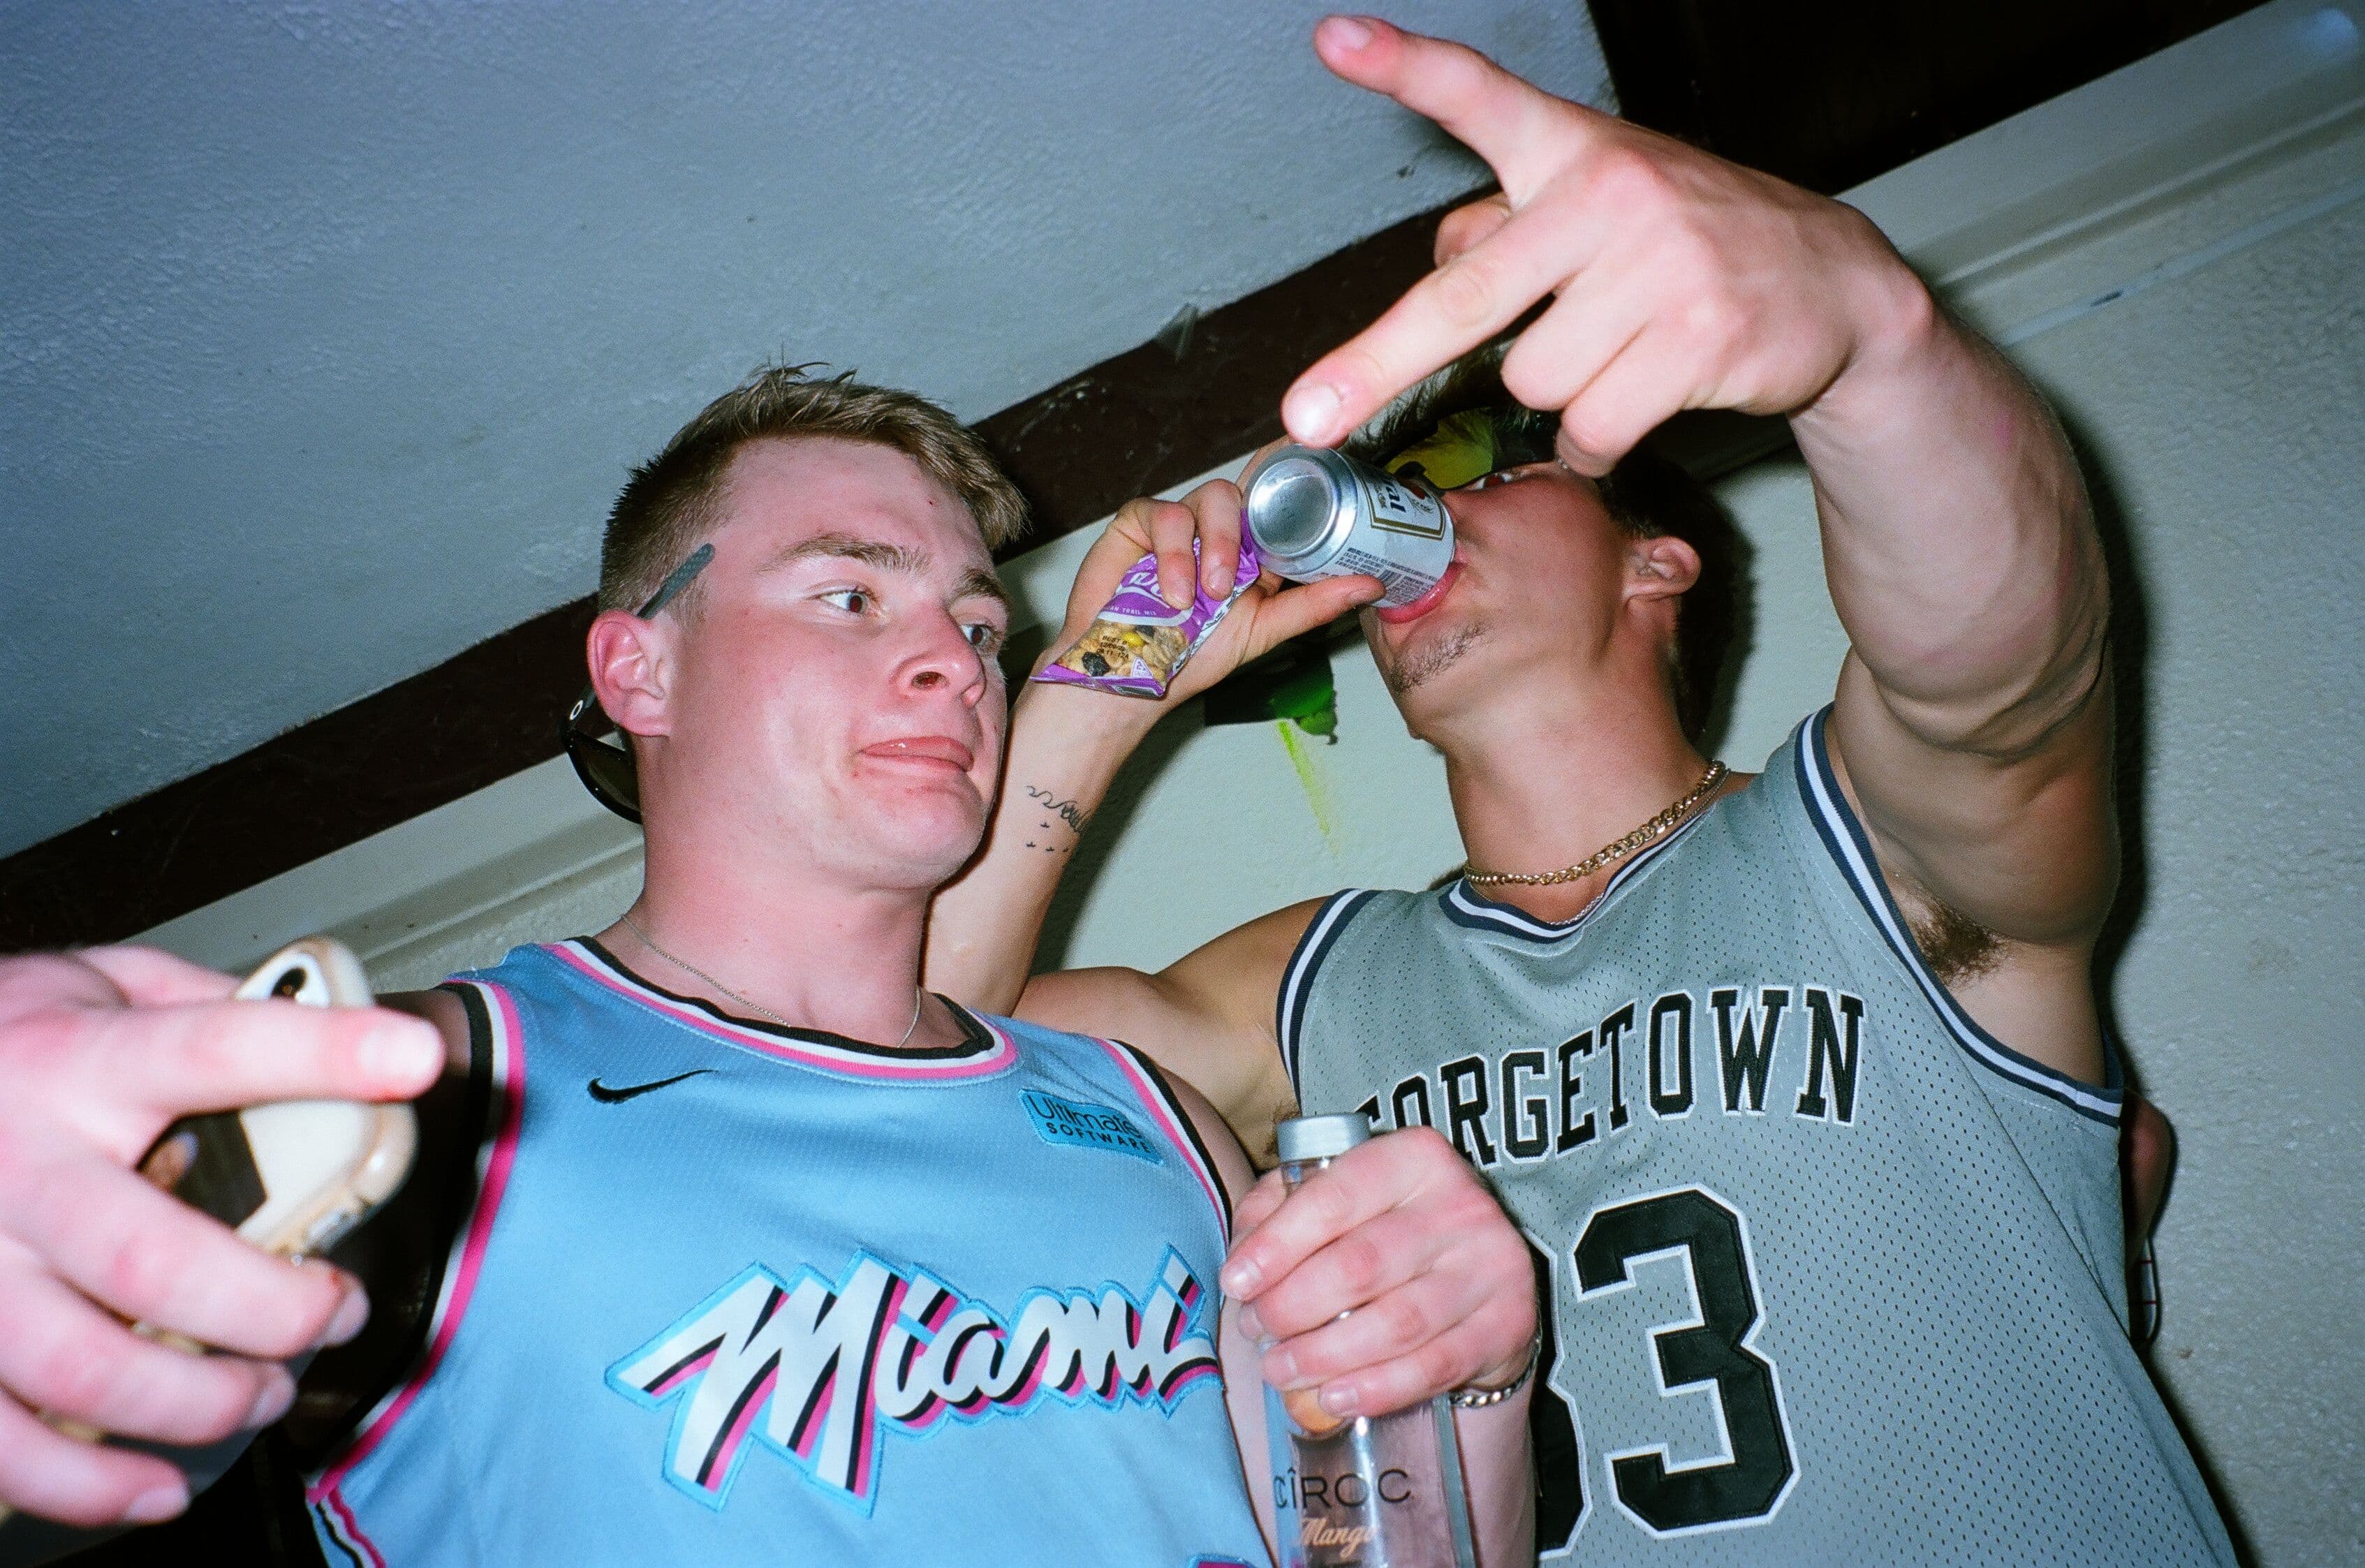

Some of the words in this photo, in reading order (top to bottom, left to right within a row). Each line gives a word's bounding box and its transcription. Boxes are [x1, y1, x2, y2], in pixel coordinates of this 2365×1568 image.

[1355, 986, 1865, 1170] ORGETOWN
[1026, 1094, 1143, 1139] Ultimate
[1045, 1122, 1152, 1154] SOFTWARE
[611, 1248, 1223, 1511] Miami
[1272, 1467, 1412, 1509] CÎROC
